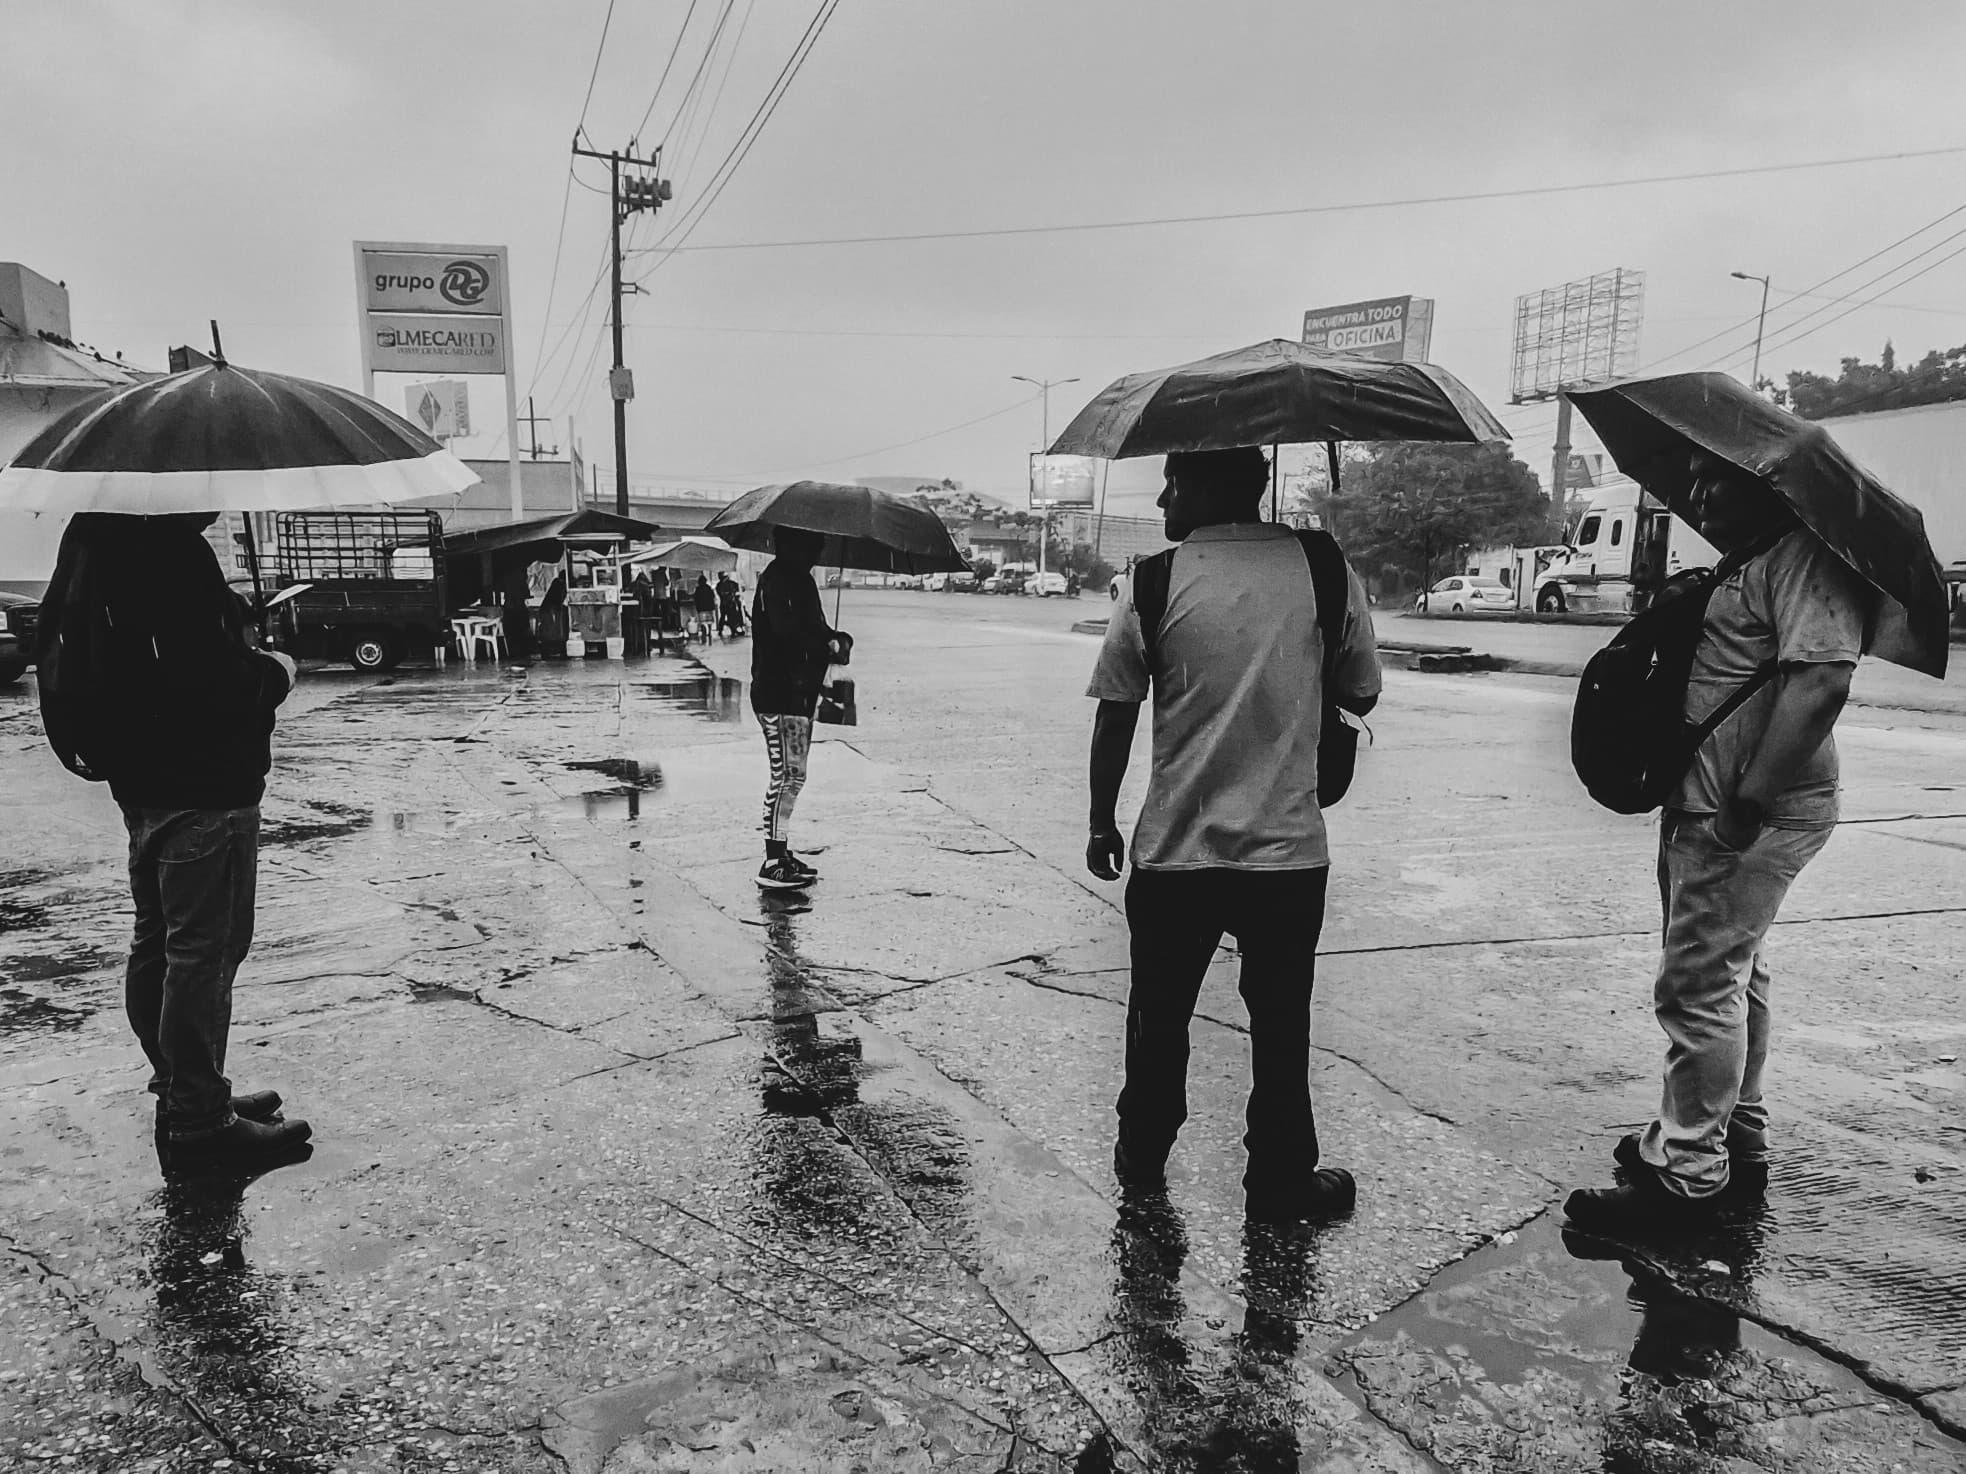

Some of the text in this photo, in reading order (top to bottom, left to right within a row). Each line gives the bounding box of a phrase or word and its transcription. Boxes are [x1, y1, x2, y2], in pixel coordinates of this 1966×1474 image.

[375, 274, 434, 292] grupo
[1306, 305, 1402, 330] ENCUENTRA TODO
[1333, 325, 1396, 347] OFICINA
